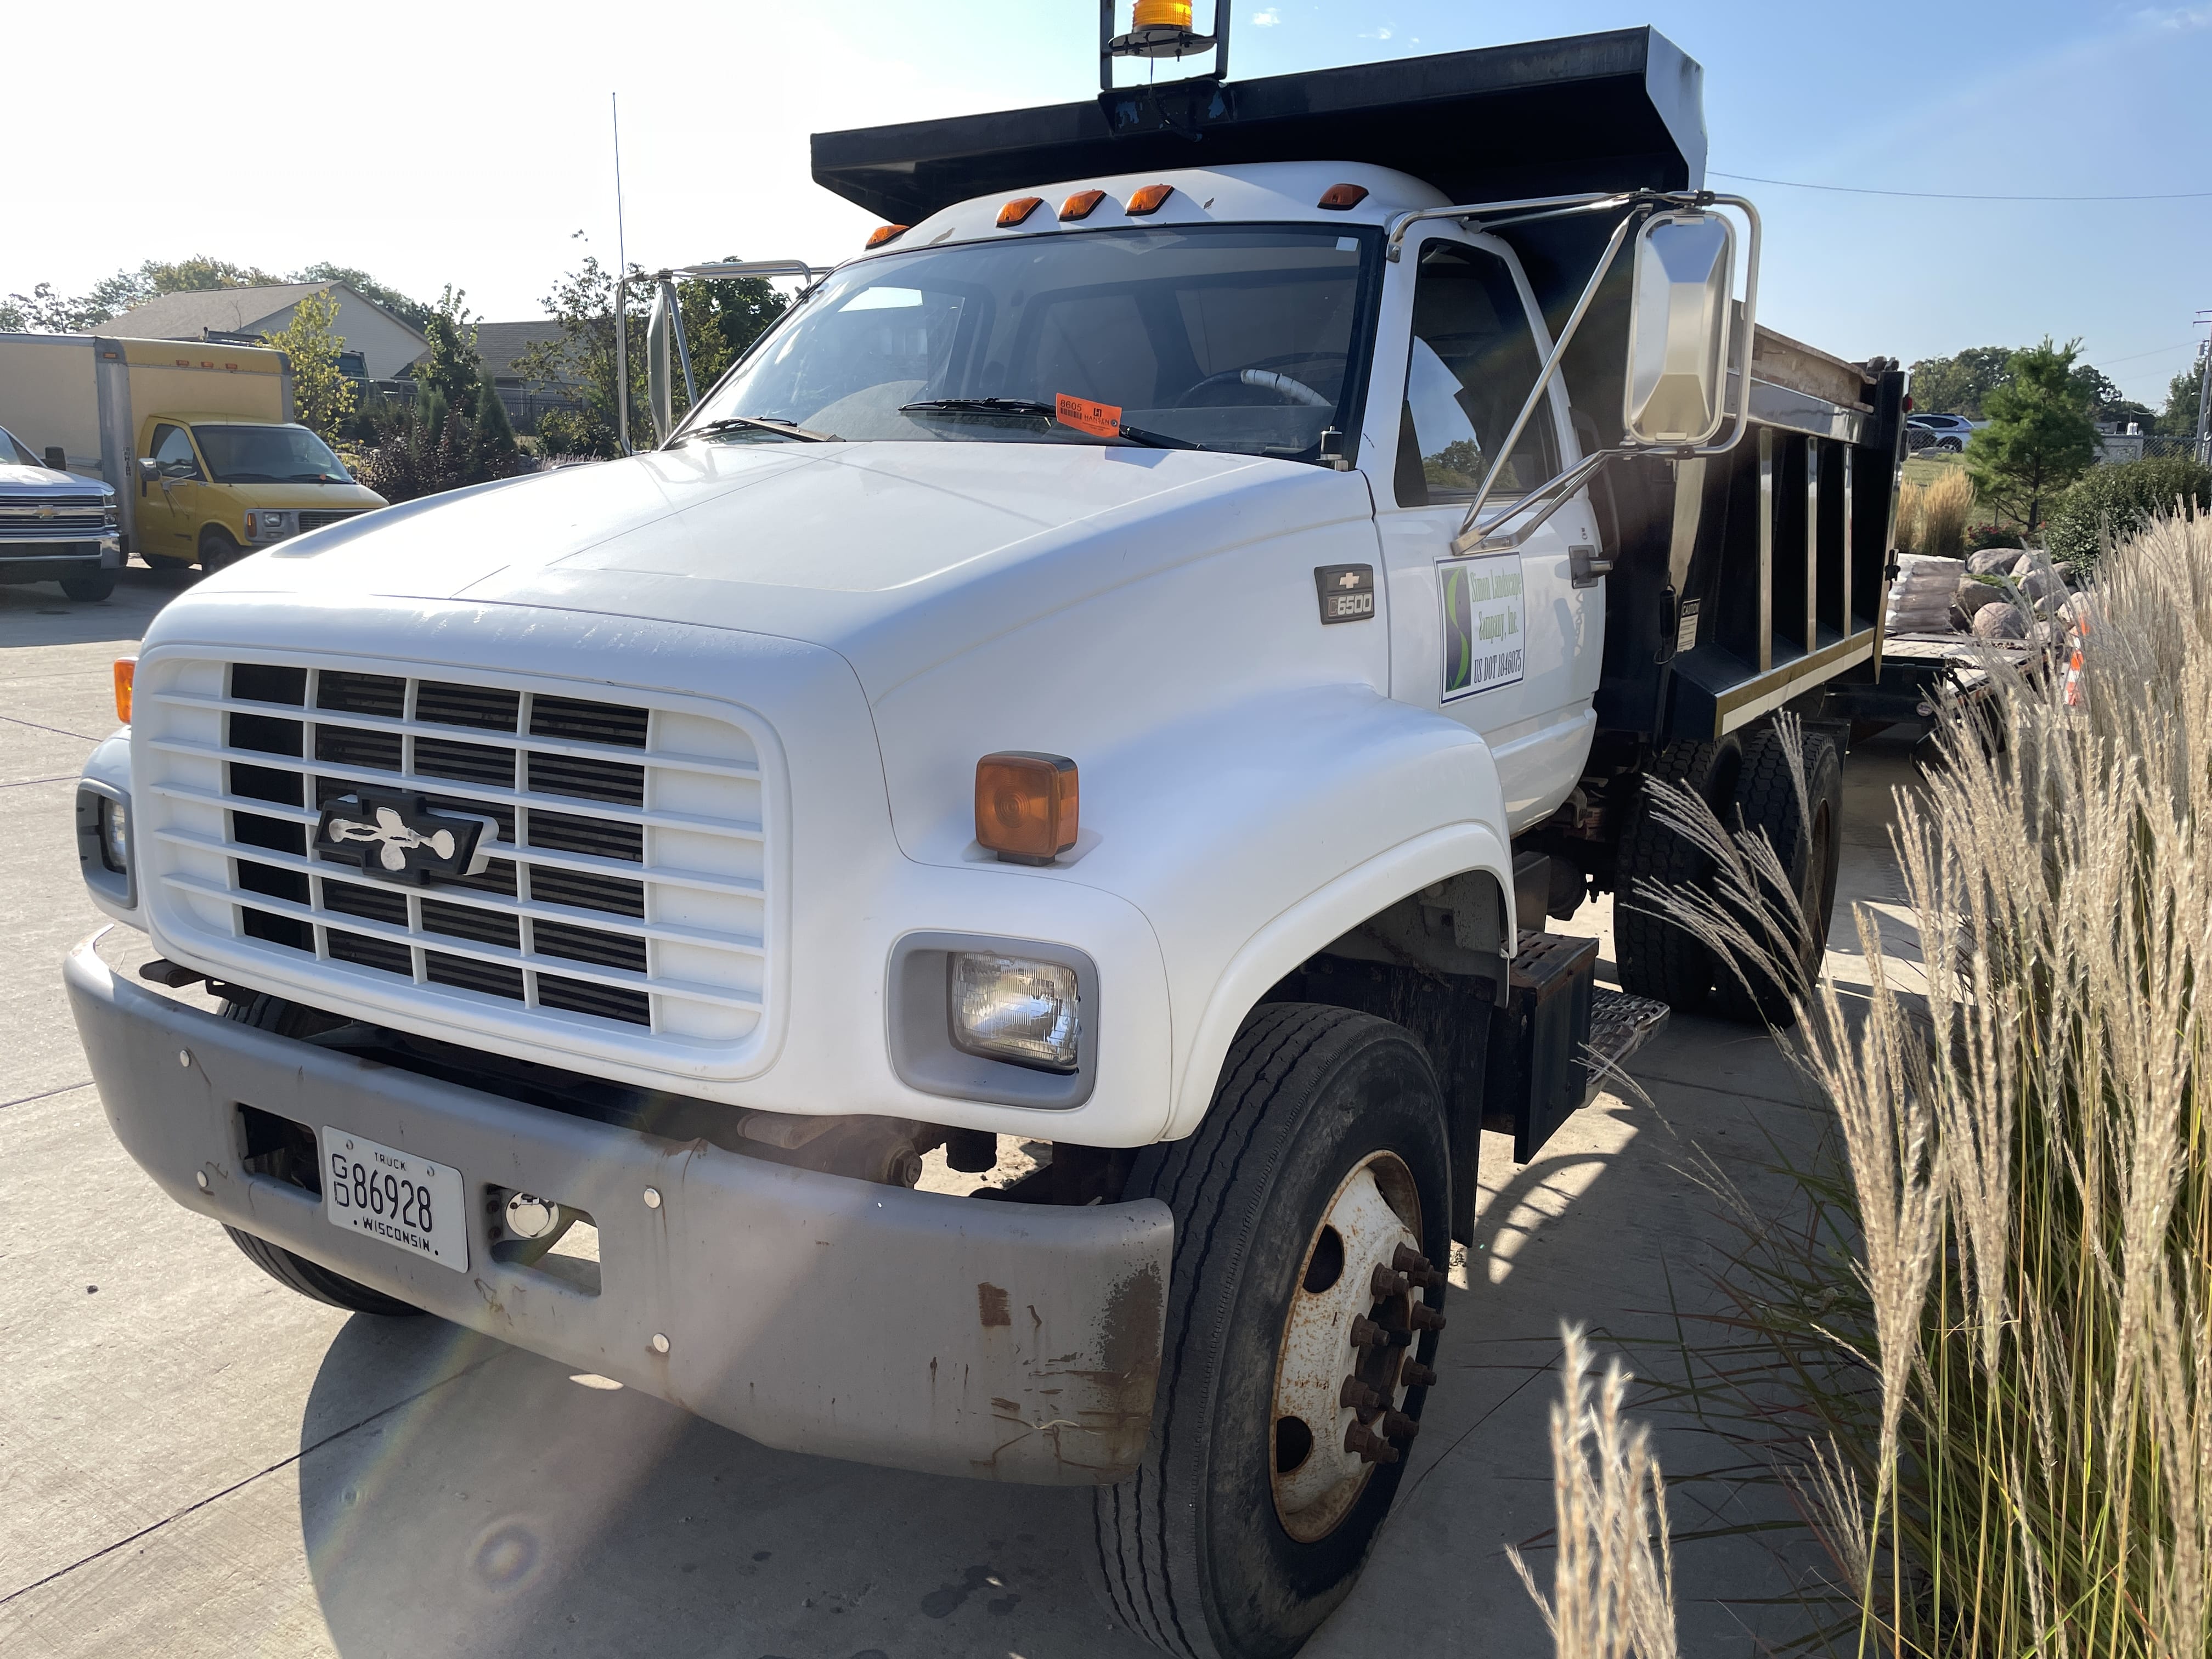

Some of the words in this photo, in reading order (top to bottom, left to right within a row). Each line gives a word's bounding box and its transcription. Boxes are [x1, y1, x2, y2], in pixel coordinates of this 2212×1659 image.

[1060, 399, 1082, 411] 8605
[1084, 414, 1109, 426] HANSEN
[1470, 572, 1491, 602] Simon
[1490, 568, 1521, 601] Landscape
[1508, 606, 1519, 634] Inc.
[1474, 658, 1482, 683] US
[1484, 655, 1497, 681] DOT
[1498, 649, 1522, 677] 1846075
[373, 1152, 406, 1171] TRUCK
[353, 1163, 432, 1233] 86928
[363, 1216, 430, 1252] WISCONSIN
